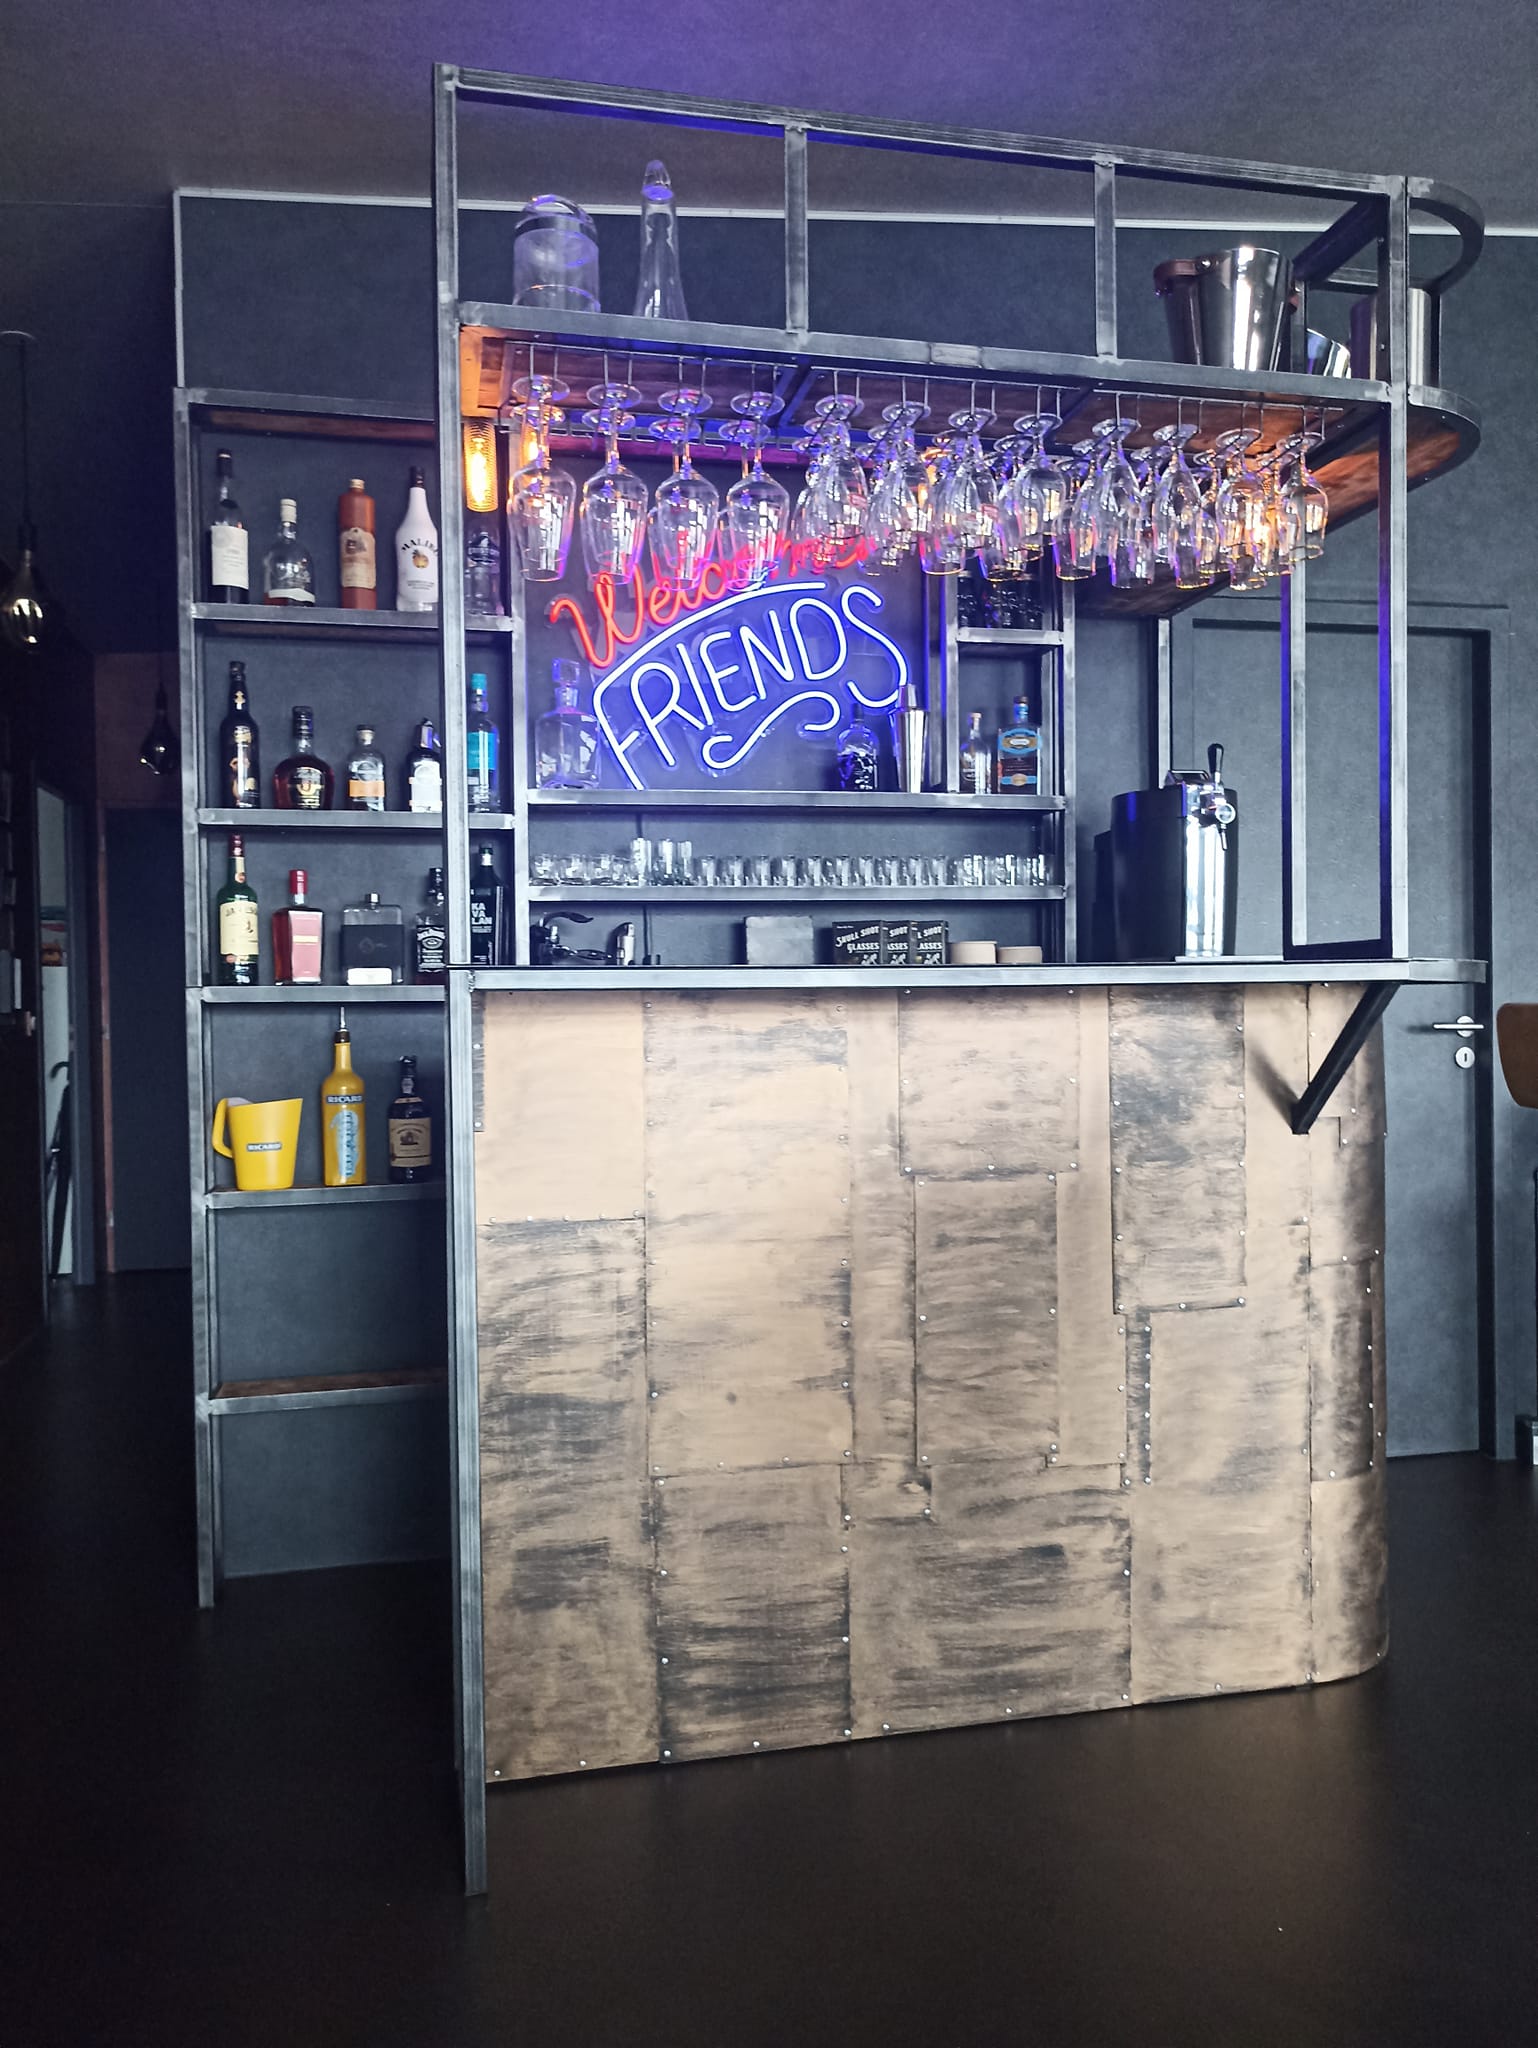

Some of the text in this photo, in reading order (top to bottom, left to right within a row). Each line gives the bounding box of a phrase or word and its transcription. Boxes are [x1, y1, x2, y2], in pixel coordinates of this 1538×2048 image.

[593, 581, 908, 791] FRIENDS
[471, 902, 486, 910] KA
[847, 942, 880, 954] GLASSES
[887, 942, 909, 951] ASSES
[917, 942, 943, 951] ASSES
